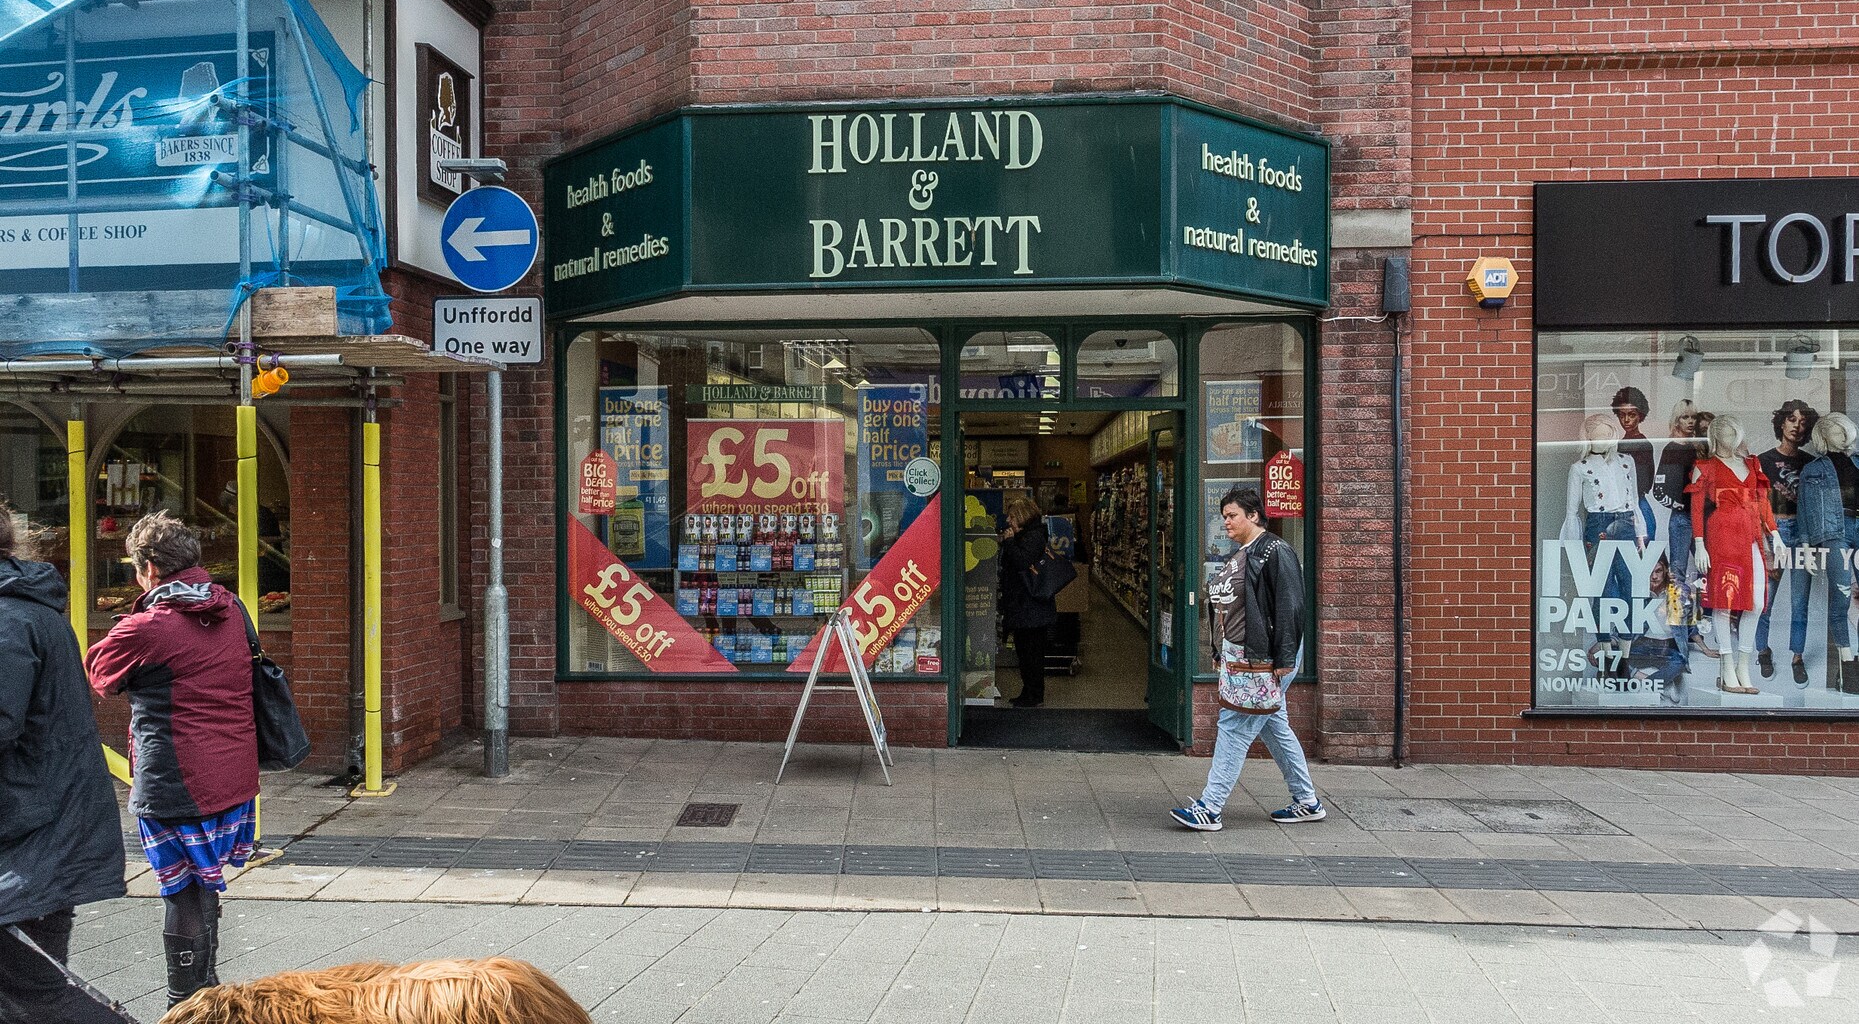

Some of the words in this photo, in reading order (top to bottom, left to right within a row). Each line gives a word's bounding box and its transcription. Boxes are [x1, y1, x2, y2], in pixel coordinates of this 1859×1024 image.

[160, 137, 200, 159] BAKERS
[203, 137, 234, 156] SINCE
[432, 134, 460, 159] COFFEE
[808, 110, 1043, 173] HOLLAND
[184, 151, 211, 162] 1838
[437, 161, 457, 187] SHOP
[1202, 143, 1254, 180] health
[1258, 158, 1302, 192] foods
[567, 174, 609, 208] health
[611, 159, 653, 194] foods
[908, 169, 939, 211] &
[1245, 197, 1261, 224] &
[21, 228, 32, 242] &
[38, 226, 98, 241] COFEE
[104, 225, 147, 239] SHOP
[601, 212, 615, 237] &
[809, 215, 1042, 278] BARRETT
[1183, 226, 1243, 254] natural
[1247, 239, 1318, 267] remedies
[554, 247, 600, 281] natural
[603, 233, 670, 269] remedies
[1485, 272, 1508, 284] ADT
[443, 306, 533, 324] Unffordd
[445, 338, 485, 354] One
[492, 340, 531, 356] way
[702, 386, 757, 401] HOLLAND
[759, 386, 772, 401] &
[773, 386, 827, 401] BARRETT
[1210, 395, 1230, 406] half
[1233, 395, 1259, 406] price
[605, 397, 632, 413] buy
[634, 400, 662, 413] one
[863, 396, 891, 413] buy
[893, 400, 921, 413] one
[606, 414, 630, 428] get
[634, 415, 662, 427] one
[863, 413, 888, 427] get
[892, 414, 920, 427] one
[605, 428, 632, 444] half
[863, 428, 890, 443] half
[614, 439, 663, 461] price
[871, 439, 921, 461] price
[584, 463, 607, 477] BIG
[701, 427, 791, 499] £5
[791, 471, 829, 499] off
[909, 468, 928, 476] Click
[909, 476, 935, 485] Collect
[1269, 465, 1293, 480] BIG
[581, 486, 600, 495] better
[585, 477, 614, 488] DEALS
[1271, 480, 1300, 490] DEALS
[581, 495, 593, 504] half
[592, 498, 614, 508] price
[1266, 490, 1287, 499] better
[702, 501, 735, 514] when
[738, 503, 761, 515] you
[764, 502, 801, 515] spend
[804, 502, 829, 514] £30
[1267, 499, 1280, 507] half
[1280, 500, 1302, 511] price
[1773, 547, 1830, 570] MEET
[1541, 539, 1668, 597] IVY
[583, 563, 655, 625] £5
[635, 623, 676, 658] off
[839, 581, 896, 656] £5
[893, 559, 928, 602] off
[1539, 597, 1667, 634] PARK
[869, 635, 888, 656] when
[886, 621, 901, 637] you
[898, 598, 919, 623] spend
[915, 584, 932, 602] £30
[584, 598, 603, 618] when
[602, 615, 617, 631] you
[615, 627, 639, 649] spend
[635, 644, 652, 662] £30
[1538, 648, 1587, 672] S/S
[1594, 650, 1623, 672] 17
[1539, 677, 1584, 692] NOW
[1586, 677, 1664, 693] INSTORE
